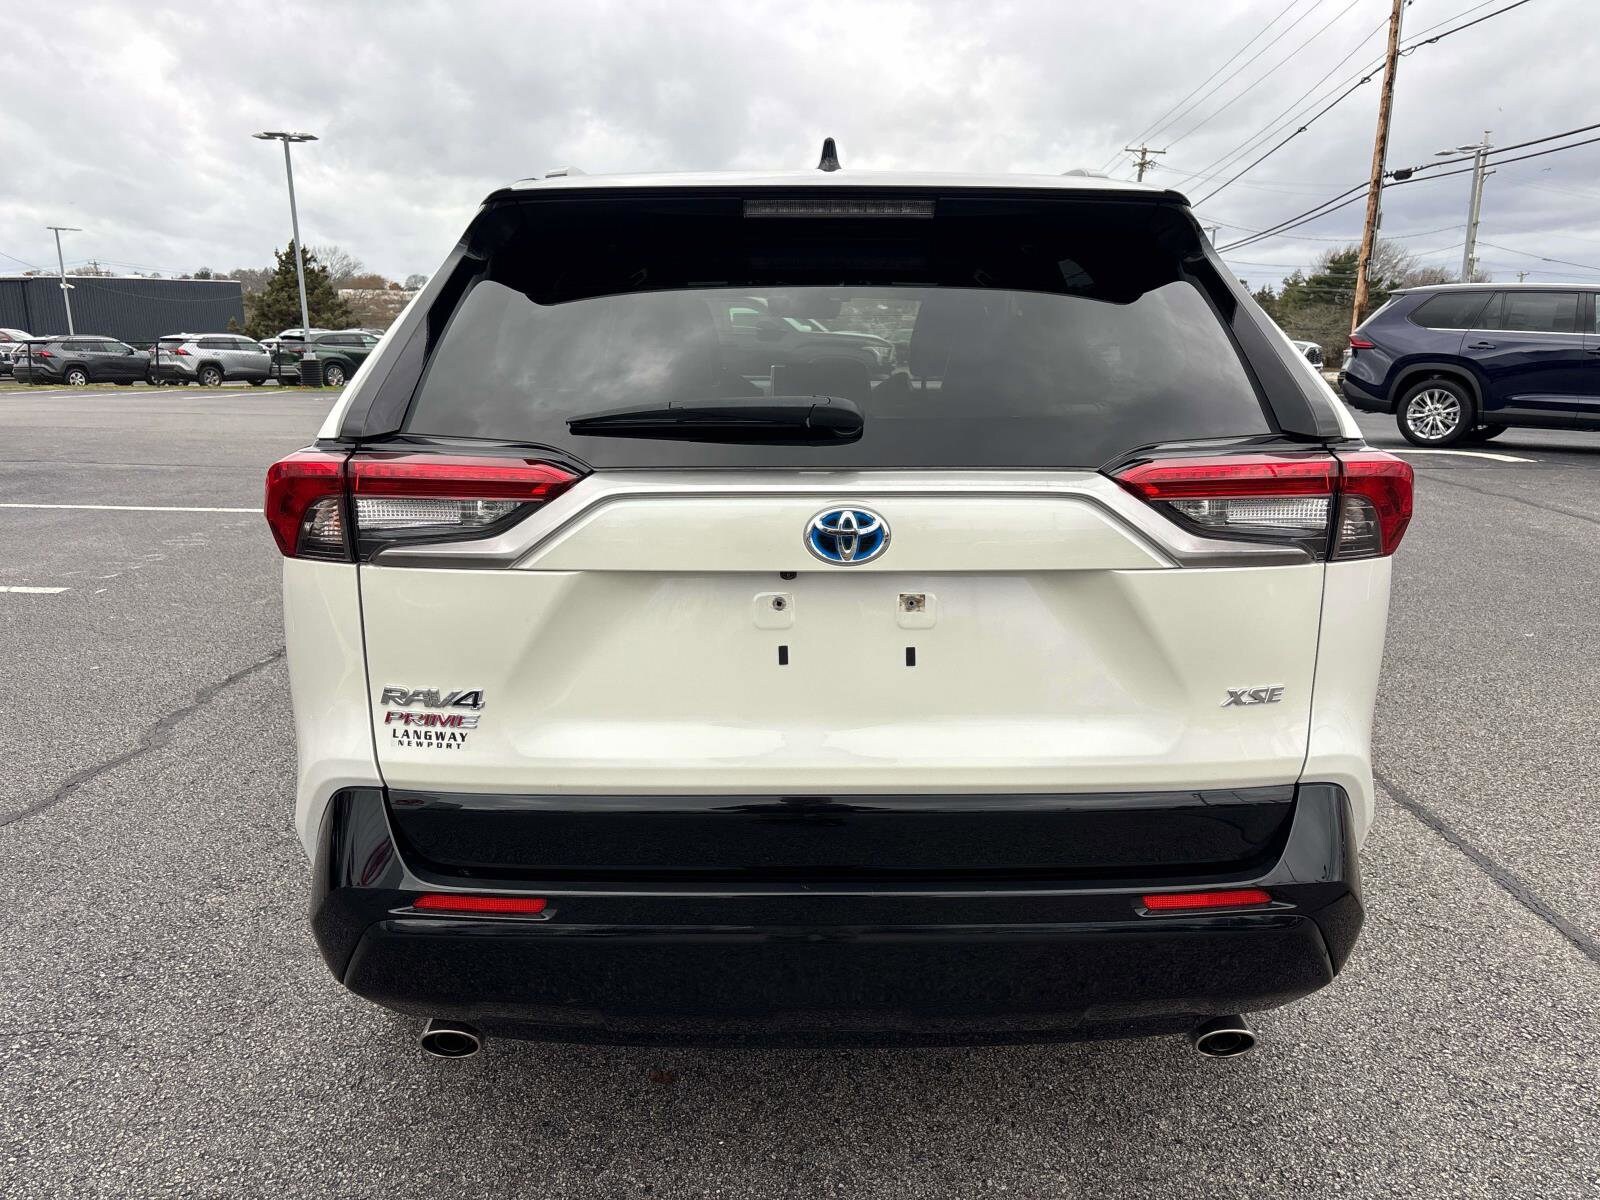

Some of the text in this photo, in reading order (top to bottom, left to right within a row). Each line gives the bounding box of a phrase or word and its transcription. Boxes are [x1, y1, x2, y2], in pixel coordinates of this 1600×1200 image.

[381, 686, 485, 710] RAV4
[1220, 685, 1285, 707] XSE
[384, 711, 480, 729] PRIME
[392, 728, 468, 742] LANGWAY
[397, 739, 462, 750] NEWPORT
